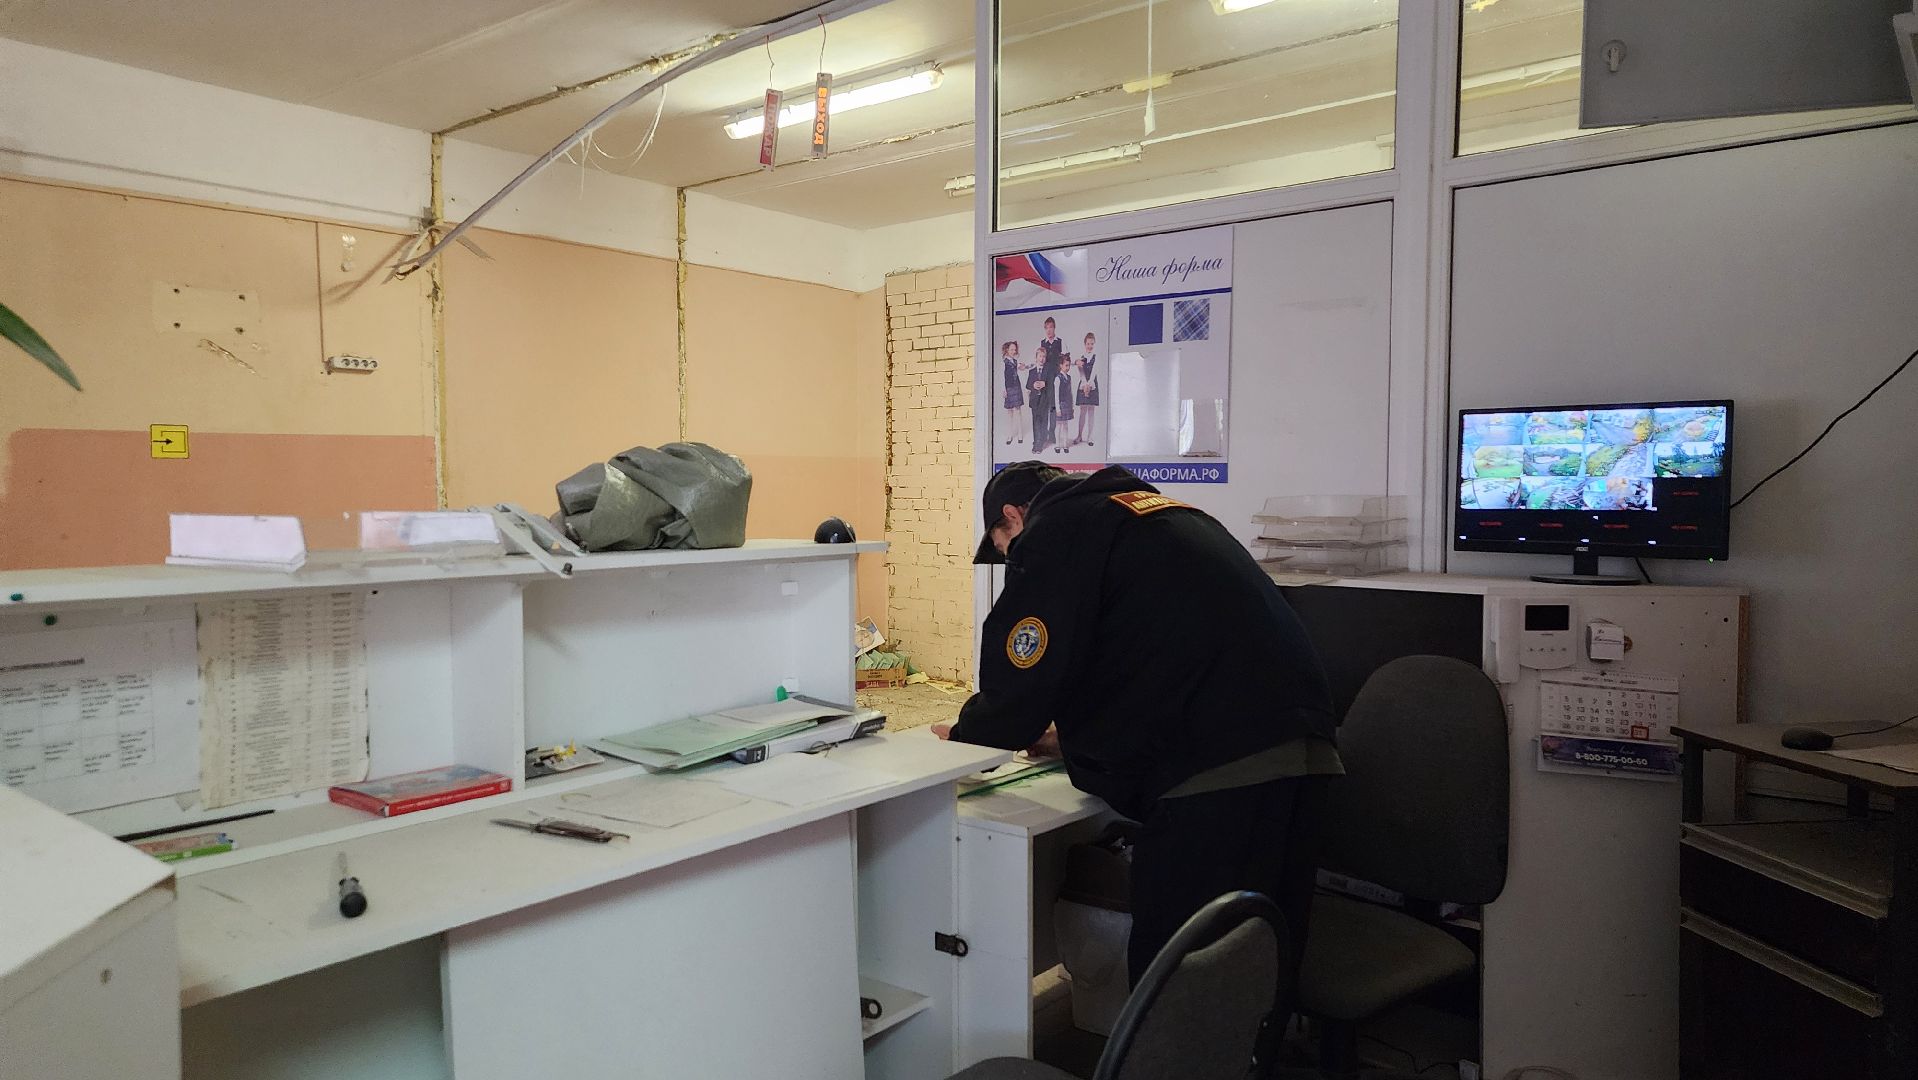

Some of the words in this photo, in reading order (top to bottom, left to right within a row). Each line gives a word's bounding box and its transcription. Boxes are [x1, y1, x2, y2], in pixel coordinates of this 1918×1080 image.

[814, 87, 828, 144] ВЫХОД
[1096, 255, 1157, 282] Наша
[1162, 256, 1222, 285] форма
